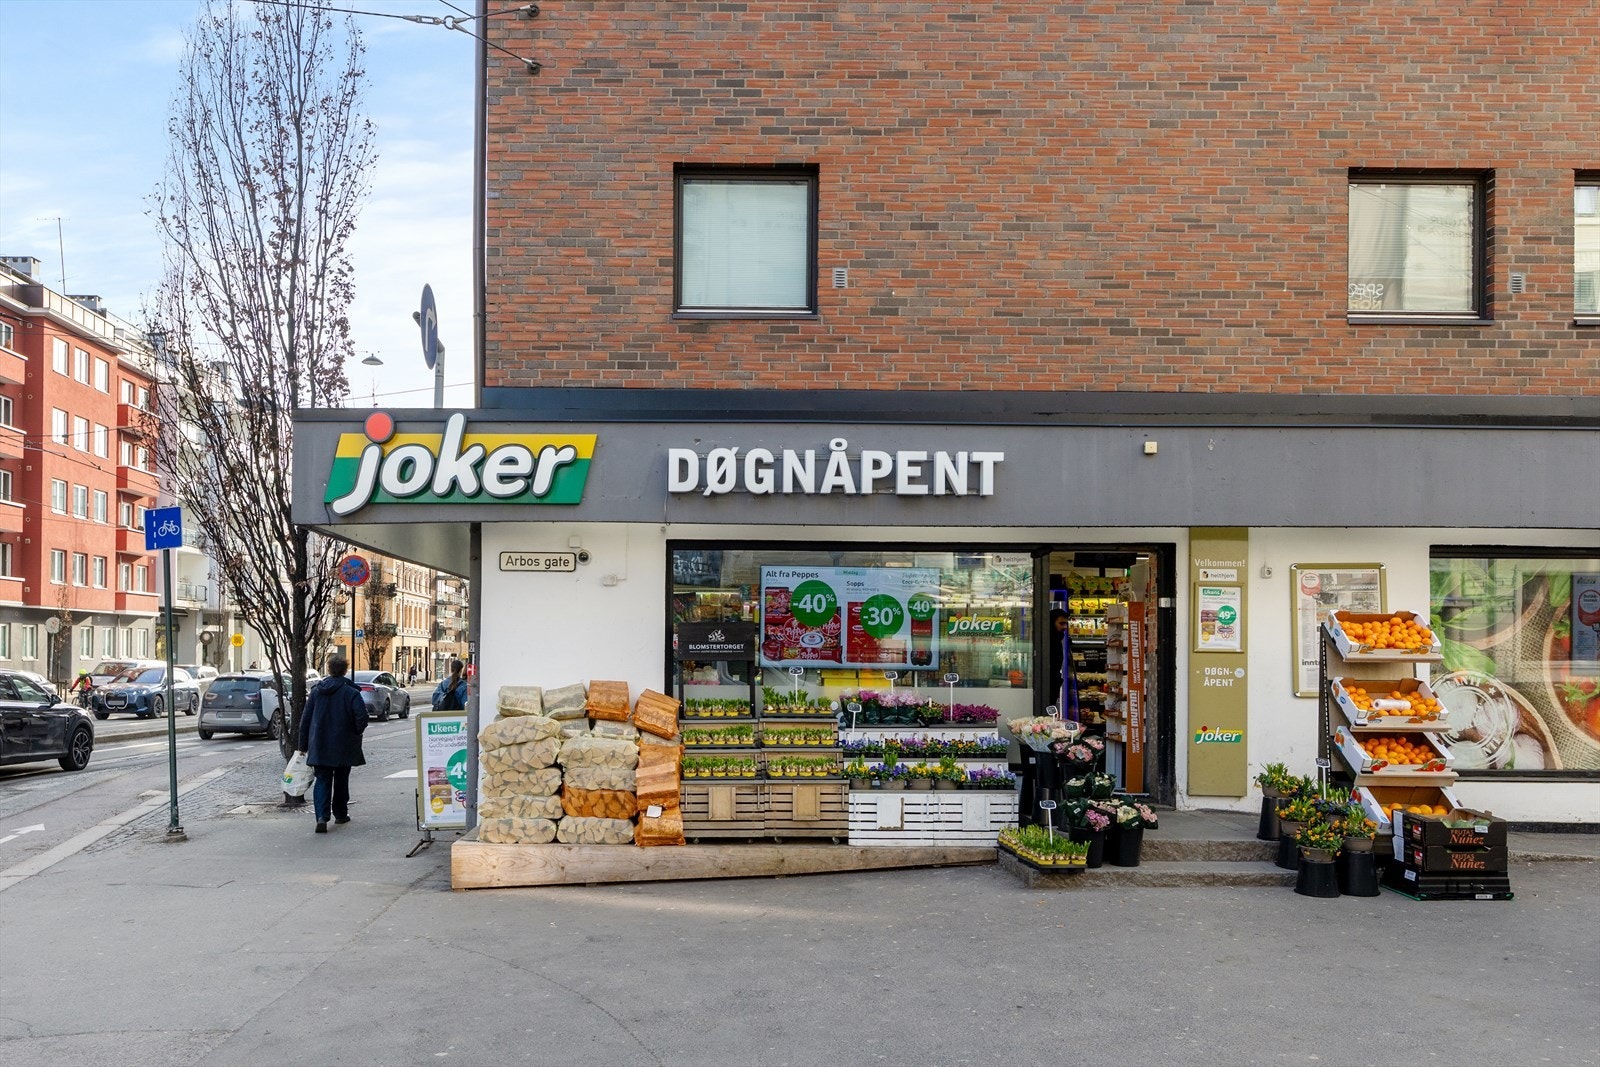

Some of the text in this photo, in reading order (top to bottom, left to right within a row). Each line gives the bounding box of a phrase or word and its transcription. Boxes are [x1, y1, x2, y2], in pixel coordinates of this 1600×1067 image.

[331, 412, 577, 516] joker
[668, 437, 1004, 497] DØGNÅPENT
[505, 555, 570, 570] Arbos gate
[1194, 558, 1245, 567] Velkommen!
[766, 570, 819, 580] Alt fra Peppes
[792, 593, 835, 613] -40%
[863, 606, 901, 626] -30%
[949, 612, 1001, 634] joker
[1204, 667, 1233, 676] DØGN-
[1203, 676, 1234, 687] ÅPENT
[430, 725, 457, 733] Ukens
[1196, 725, 1240, 744] joker
